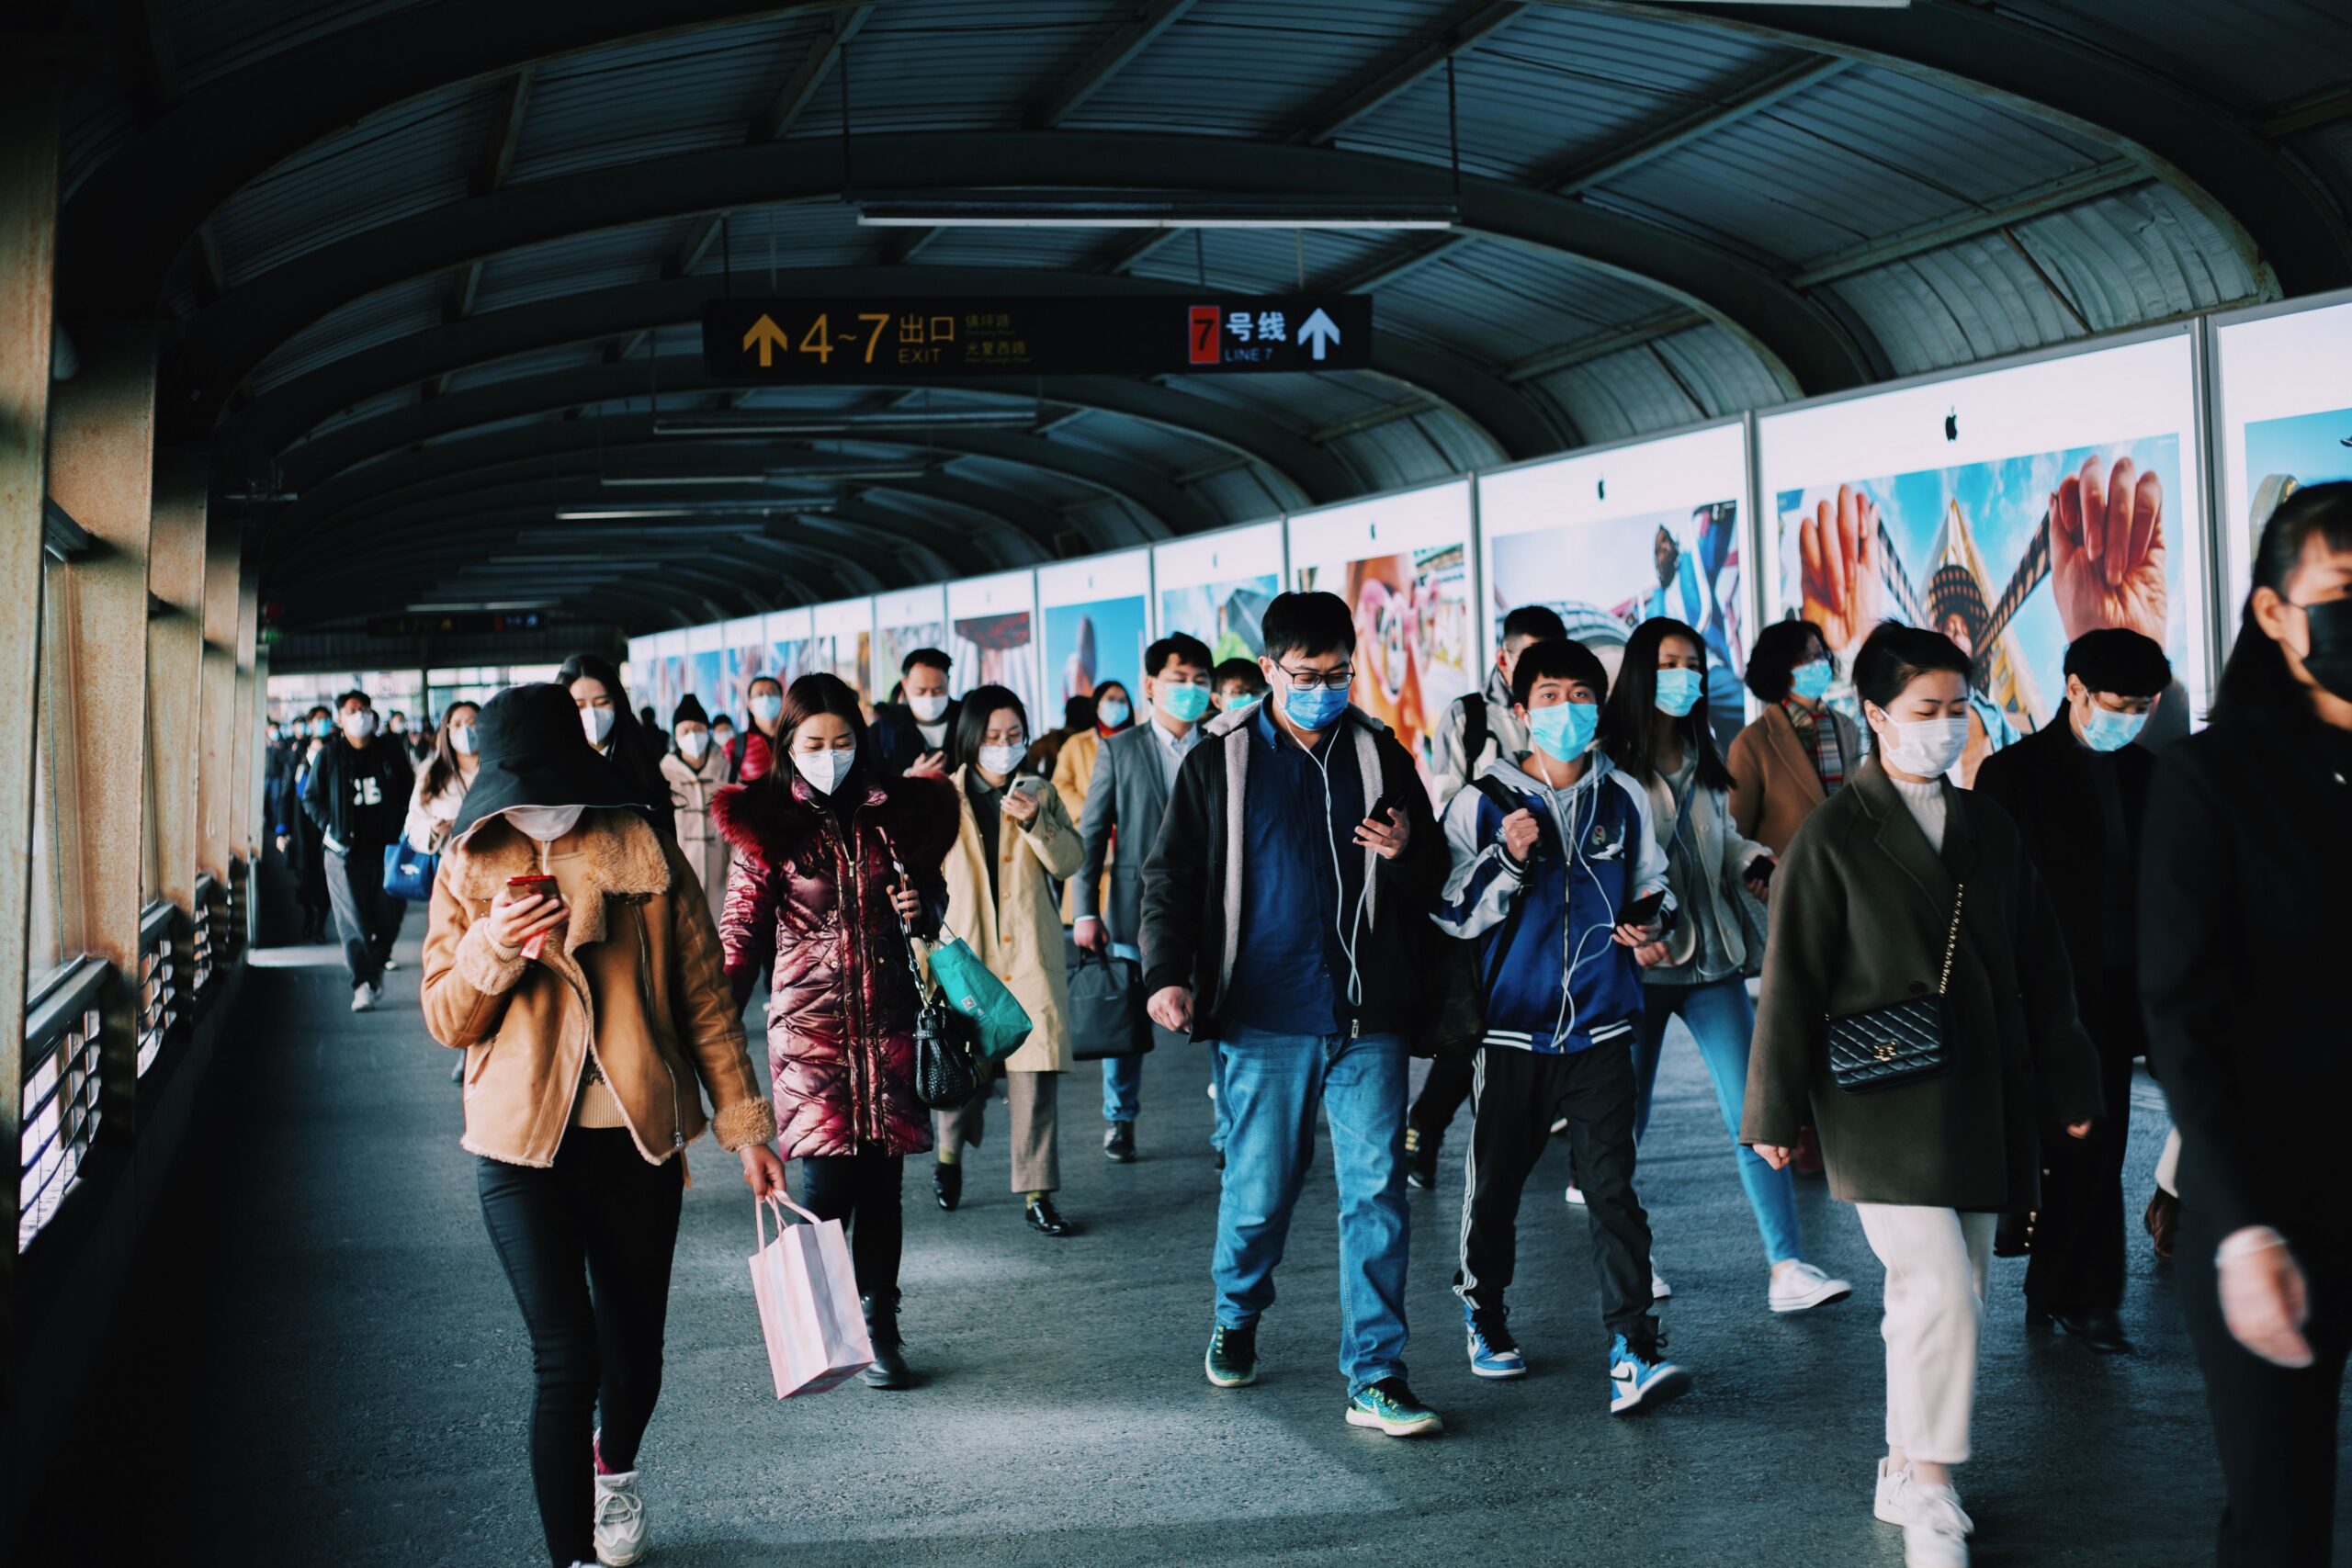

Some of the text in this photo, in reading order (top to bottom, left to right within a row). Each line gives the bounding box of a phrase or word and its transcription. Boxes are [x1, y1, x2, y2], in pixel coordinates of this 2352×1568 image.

[799, 313, 890, 364] 4~7
[899, 313, 956, 344] 出口
[1193, 311, 1287, 351] 7 号线
[898, 348, 942, 364] EXIT
[1225, 347, 1273, 363] LINE 7
